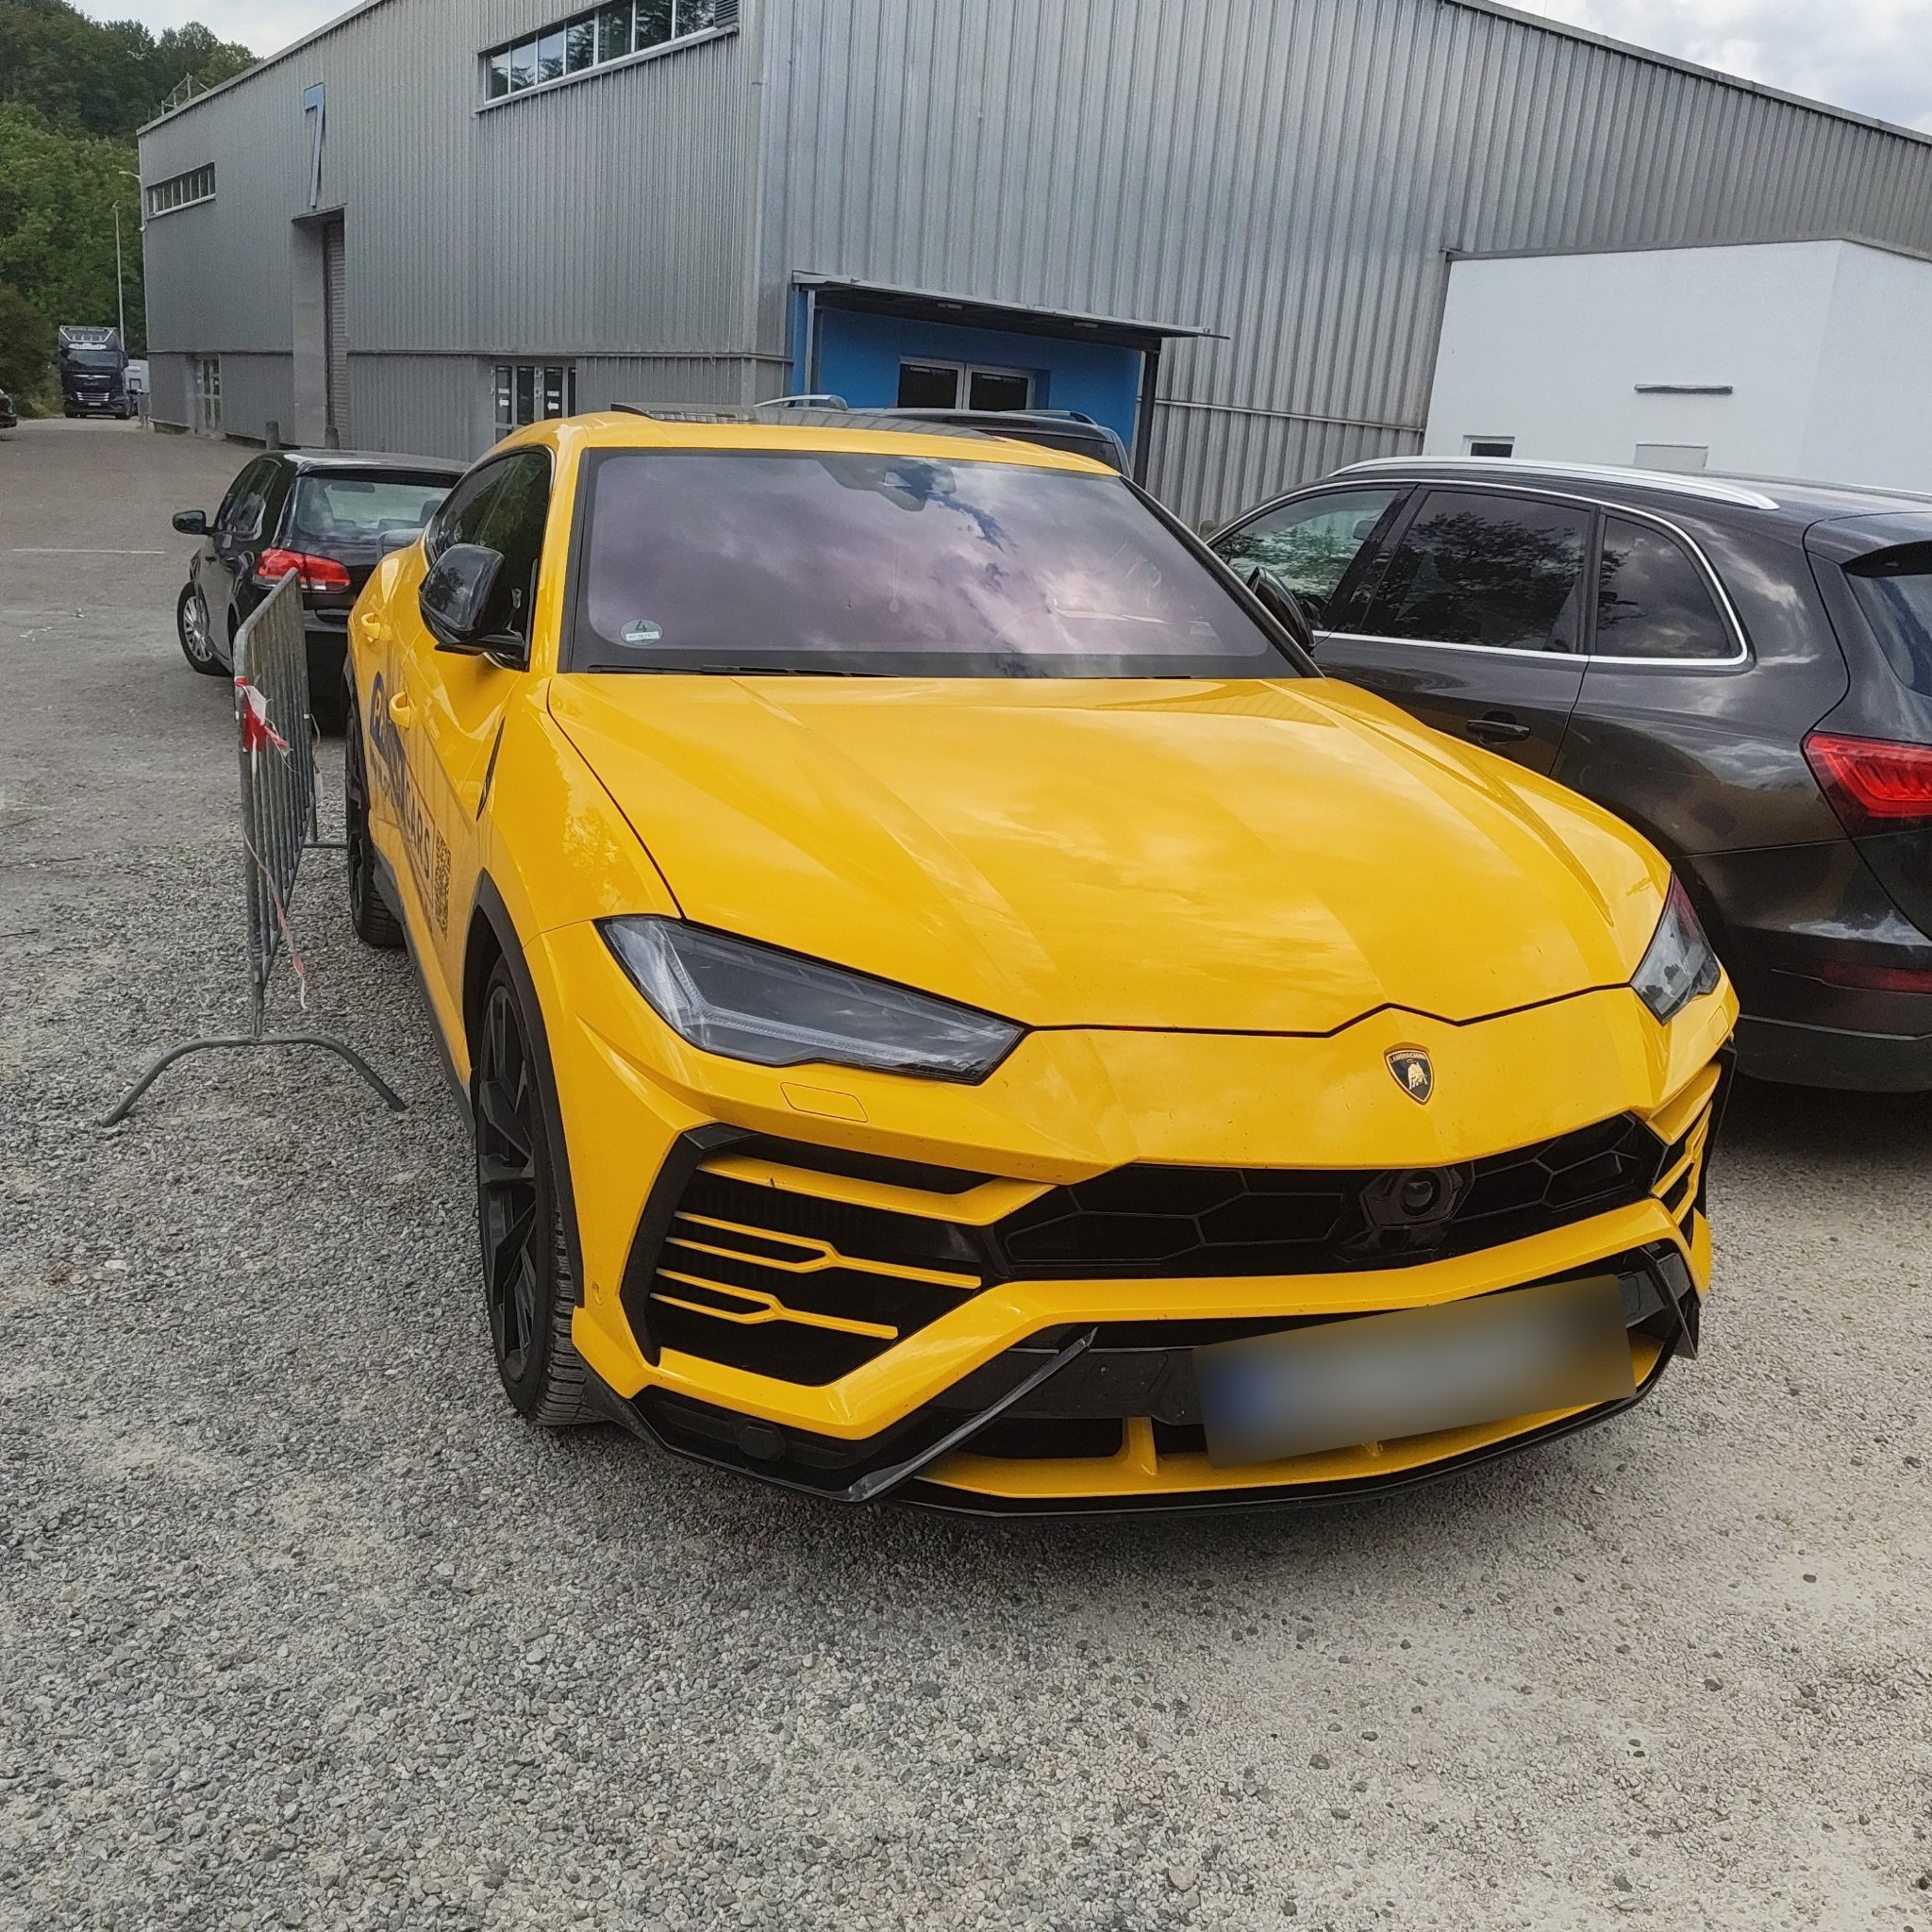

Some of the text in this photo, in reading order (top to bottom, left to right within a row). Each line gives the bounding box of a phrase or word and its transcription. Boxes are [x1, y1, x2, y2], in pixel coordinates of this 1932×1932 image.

[304, 82, 325, 207] 7
[635, 620, 648, 632] 4
[405, 781, 430, 880] CARS
